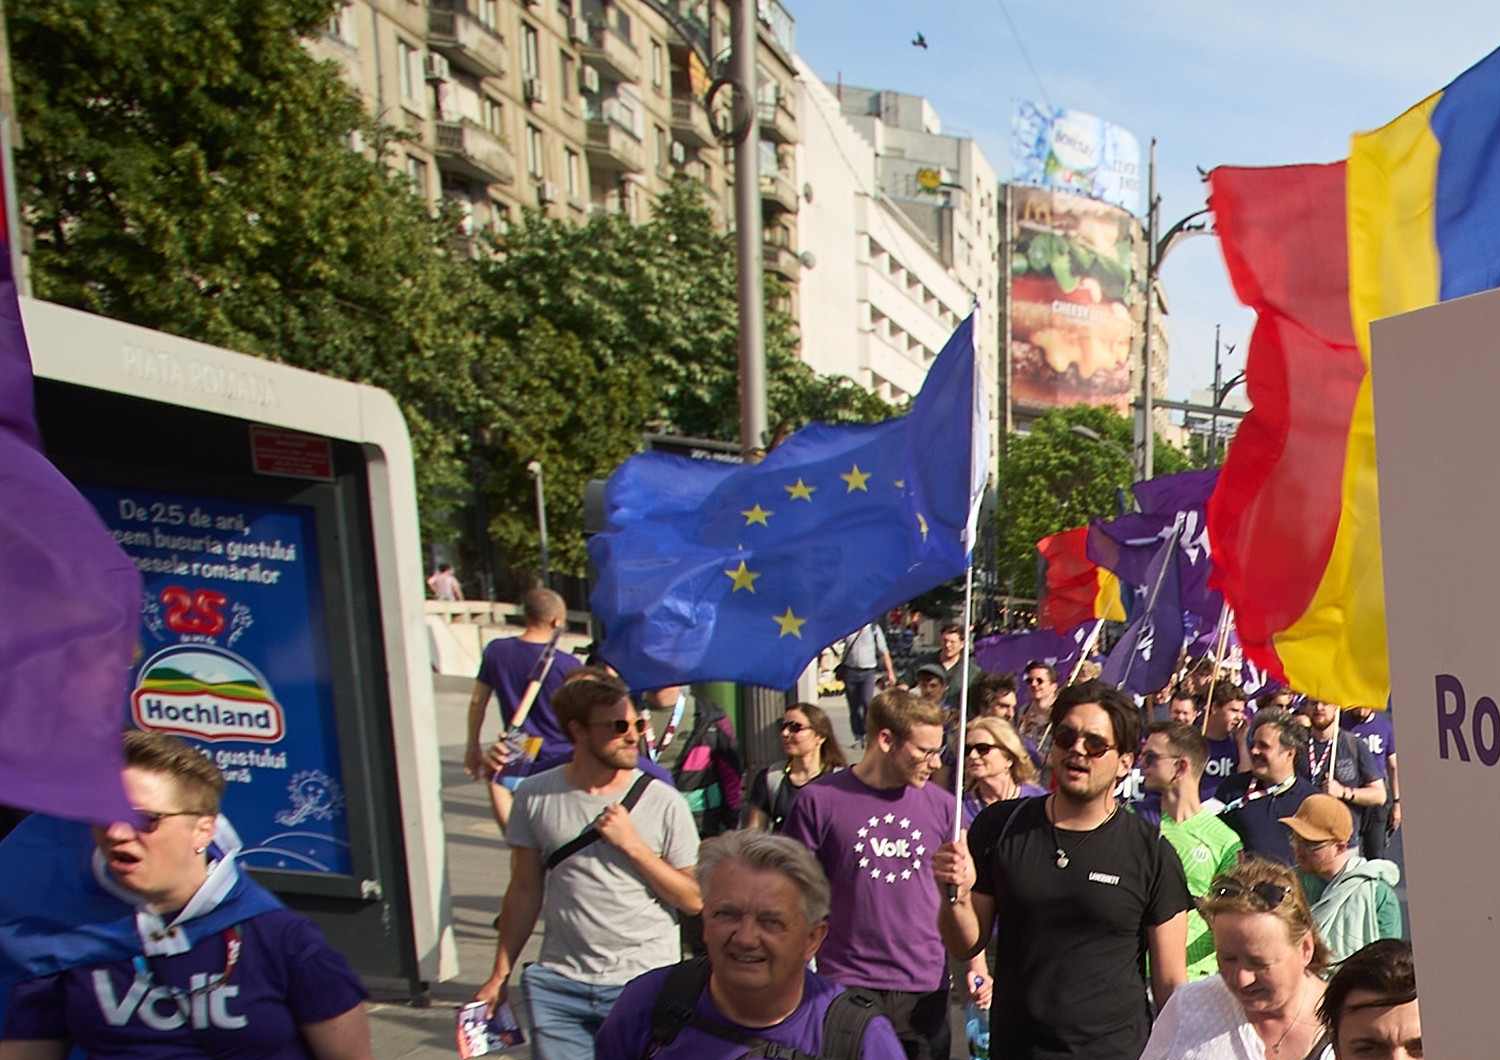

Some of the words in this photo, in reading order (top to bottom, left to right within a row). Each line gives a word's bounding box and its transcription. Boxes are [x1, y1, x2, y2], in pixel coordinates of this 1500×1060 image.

[119, 499, 148, 521] De
[150, 502, 186, 526] 25
[188, 506, 212, 529] de
[216, 512, 251, 536] ani,
[153, 526, 223, 555] bucuria
[226, 539, 297, 562] gustului
[192, 559, 281, 584] românilor
[160, 585, 229, 637] 25
[146, 698, 272, 729] Hochland
[216, 748, 287, 769] gustului
[1203, 757, 1235, 778] olt
[869, 837, 912, 858] Volt
[91, 968, 248, 1031] Volt
